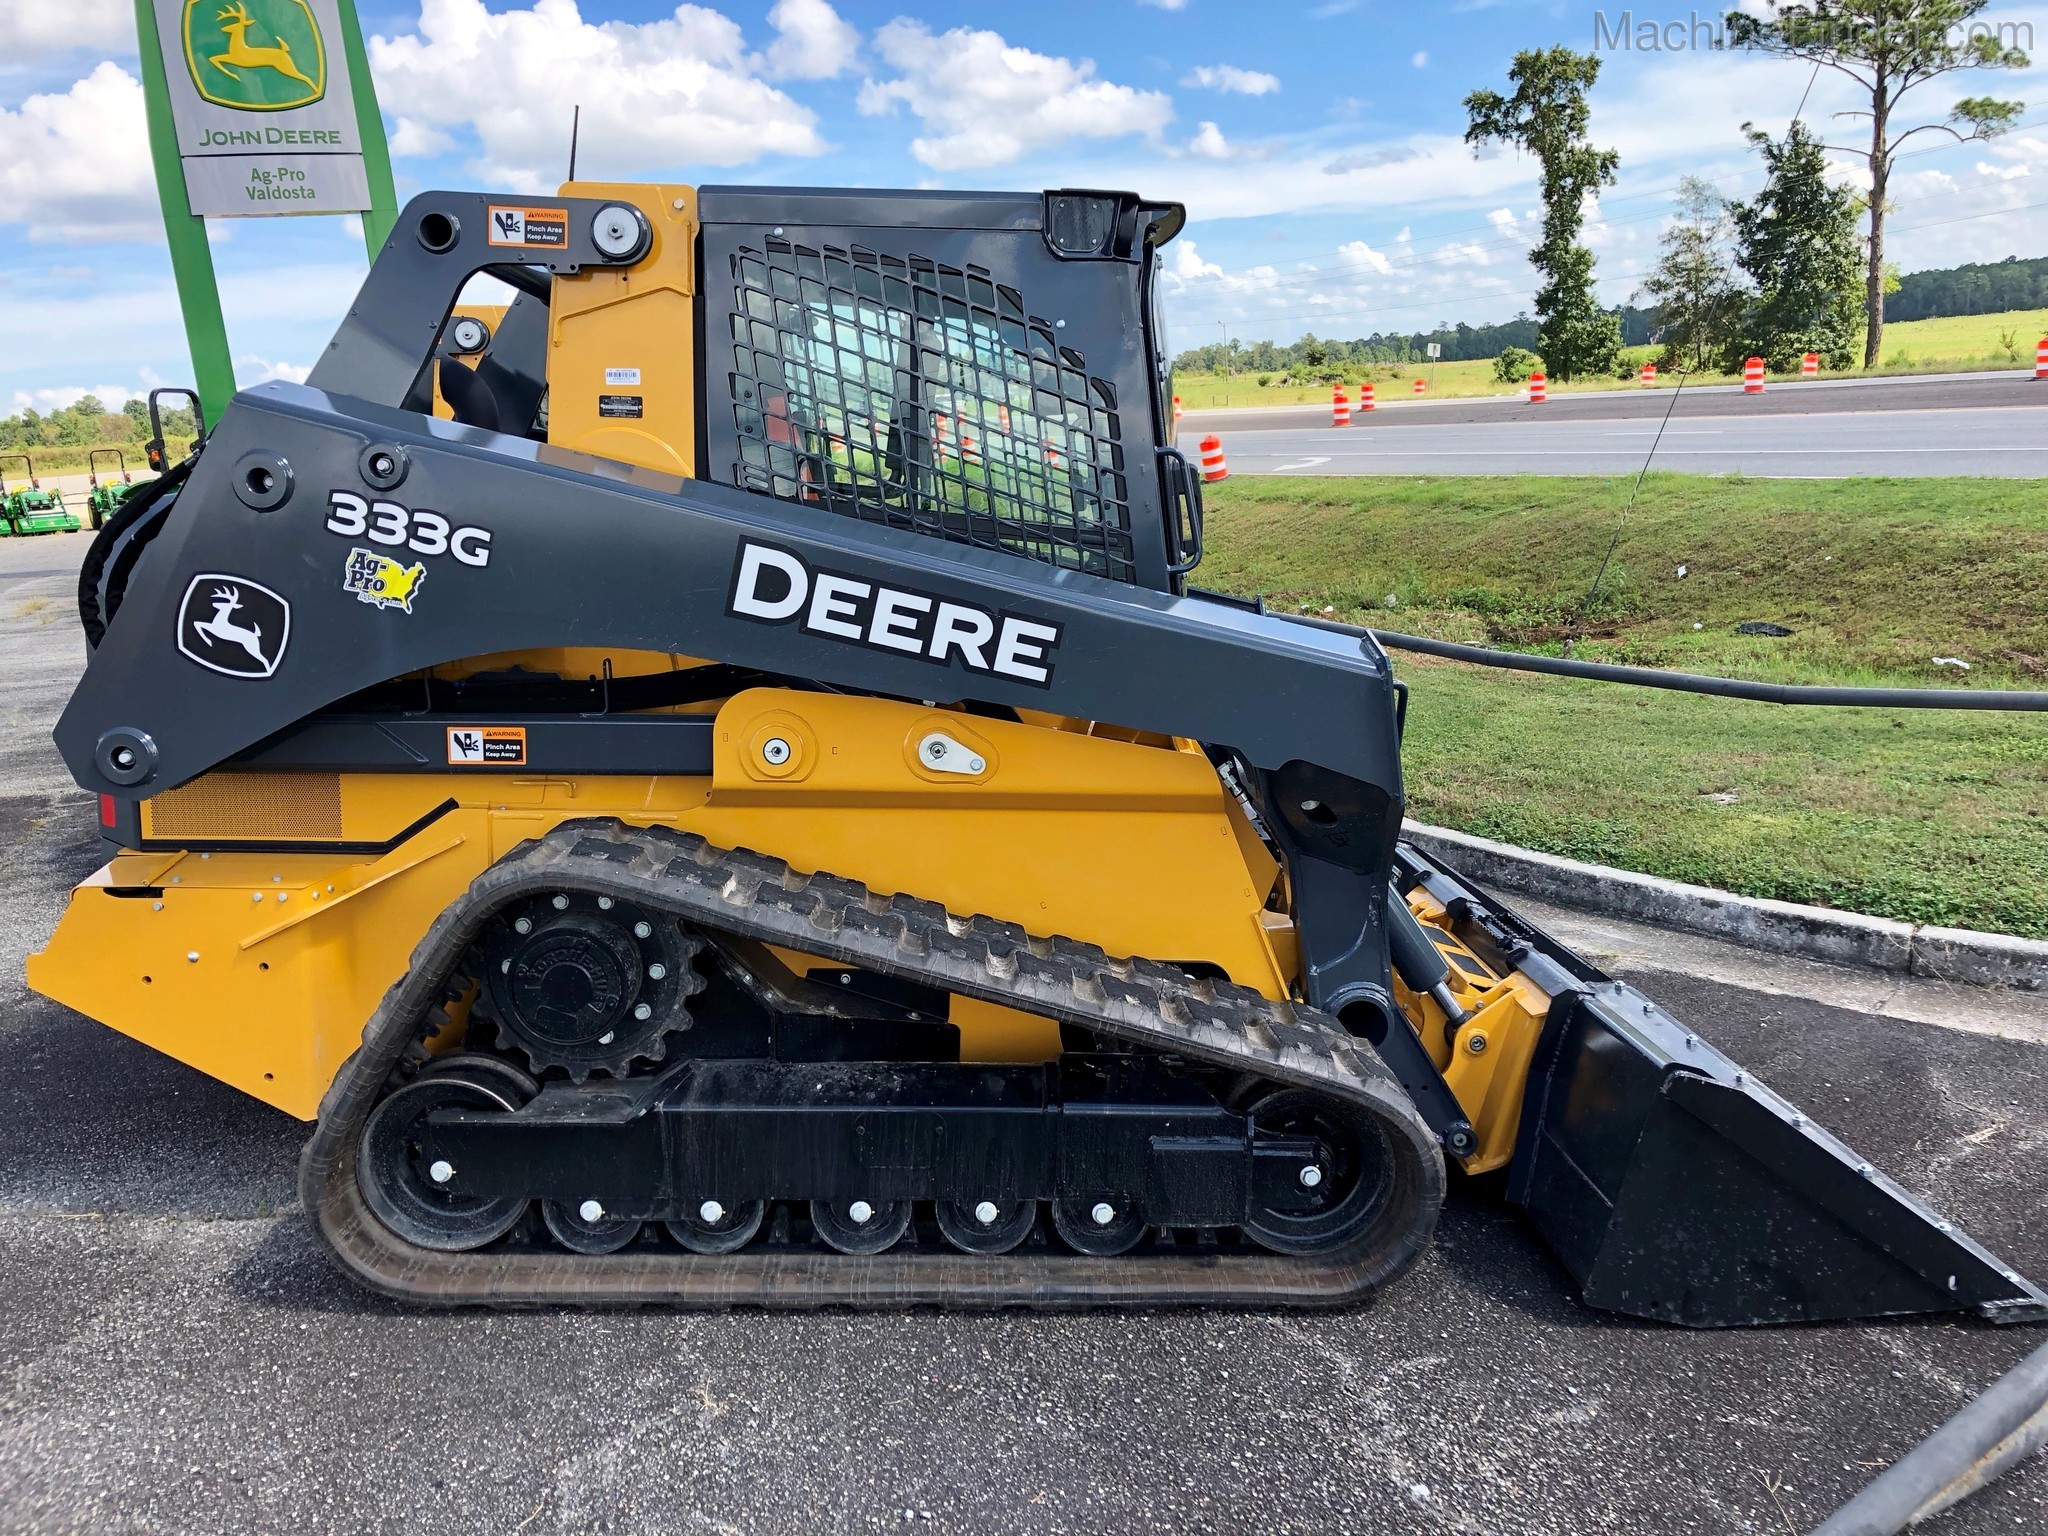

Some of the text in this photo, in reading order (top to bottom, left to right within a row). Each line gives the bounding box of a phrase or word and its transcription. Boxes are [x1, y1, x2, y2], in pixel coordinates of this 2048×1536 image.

[199, 127, 342, 147] JOHN DEERE
[251, 168, 305, 185] Ag-Pro
[245, 185, 316, 201] Valdosta
[542, 234, 557, 242] Away
[326, 492, 492, 567] 333G
[350, 552, 388, 576] Ag-
[348, 570, 385, 592] Pro
[732, 543, 1057, 682] DEERE
